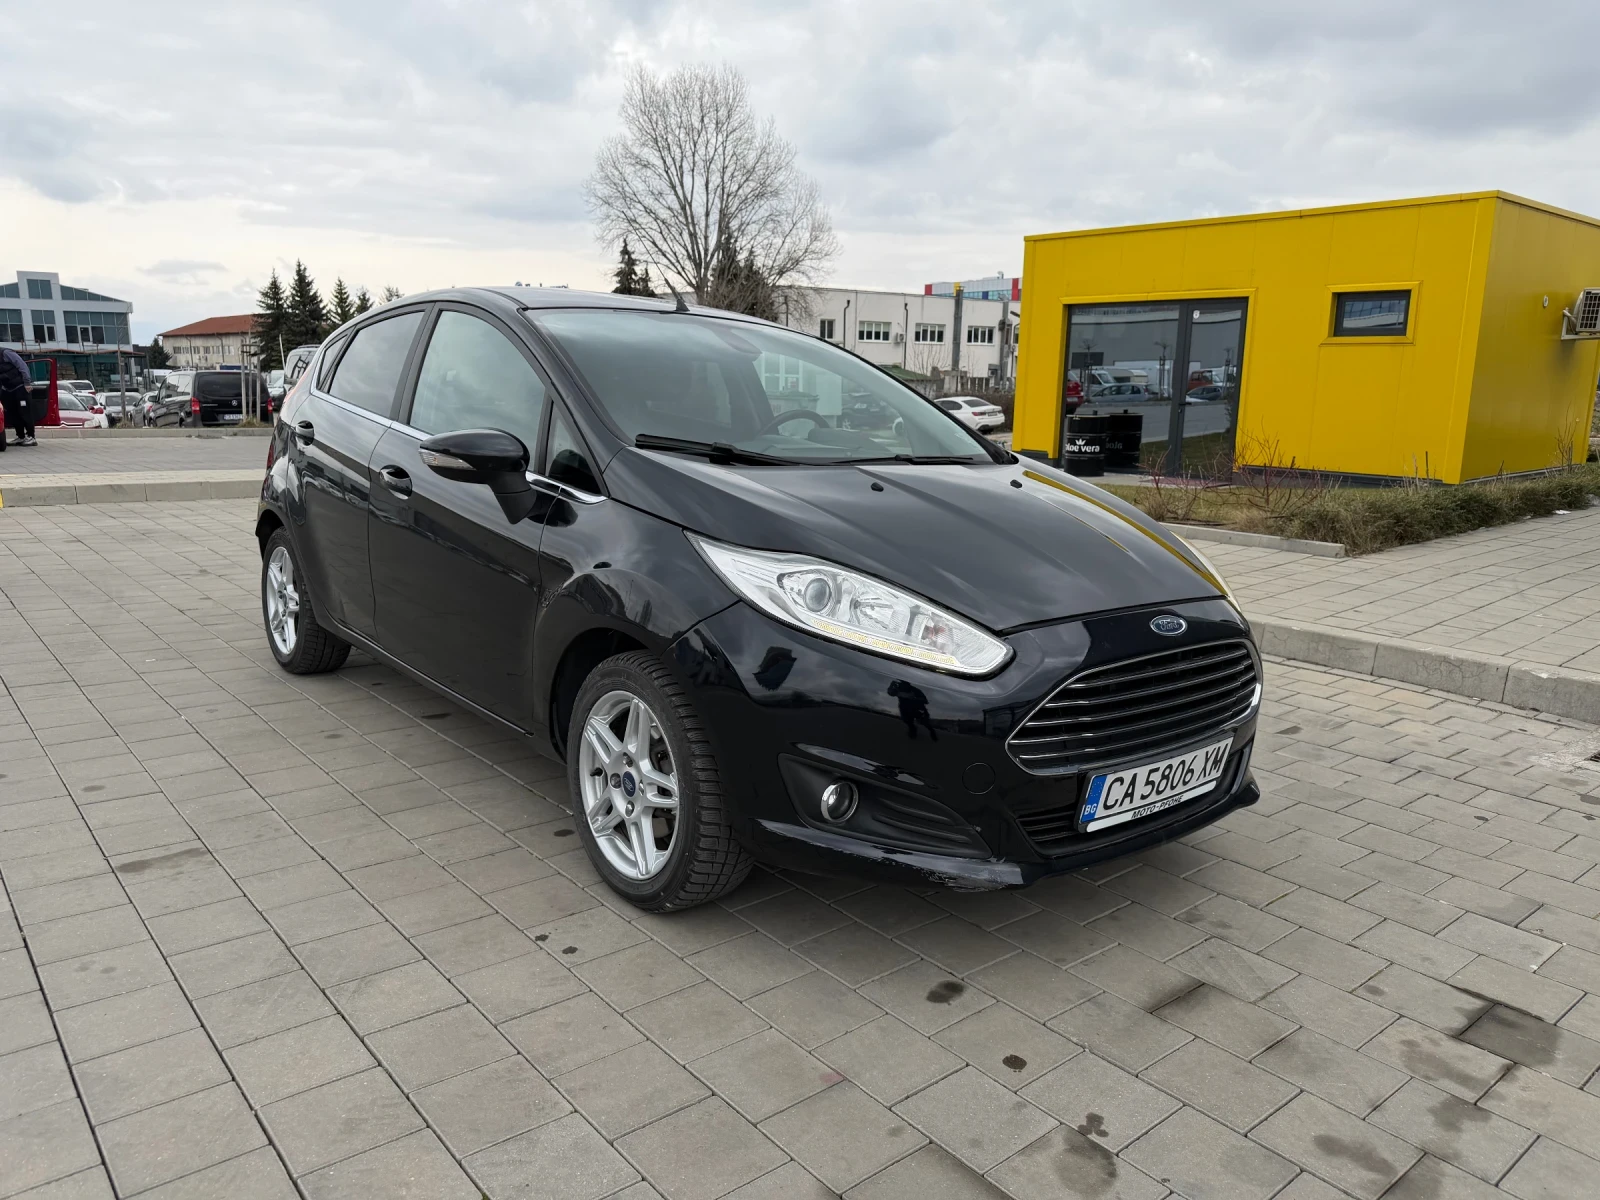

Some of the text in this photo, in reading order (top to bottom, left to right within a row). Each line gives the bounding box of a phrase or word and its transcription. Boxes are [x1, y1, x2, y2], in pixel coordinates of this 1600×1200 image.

[1080, 445, 1100, 453] vera
[1159, 619, 1180, 631] Ford
[1103, 743, 1229, 811] CA 5806 XM
[1084, 803, 1098, 816] BG
